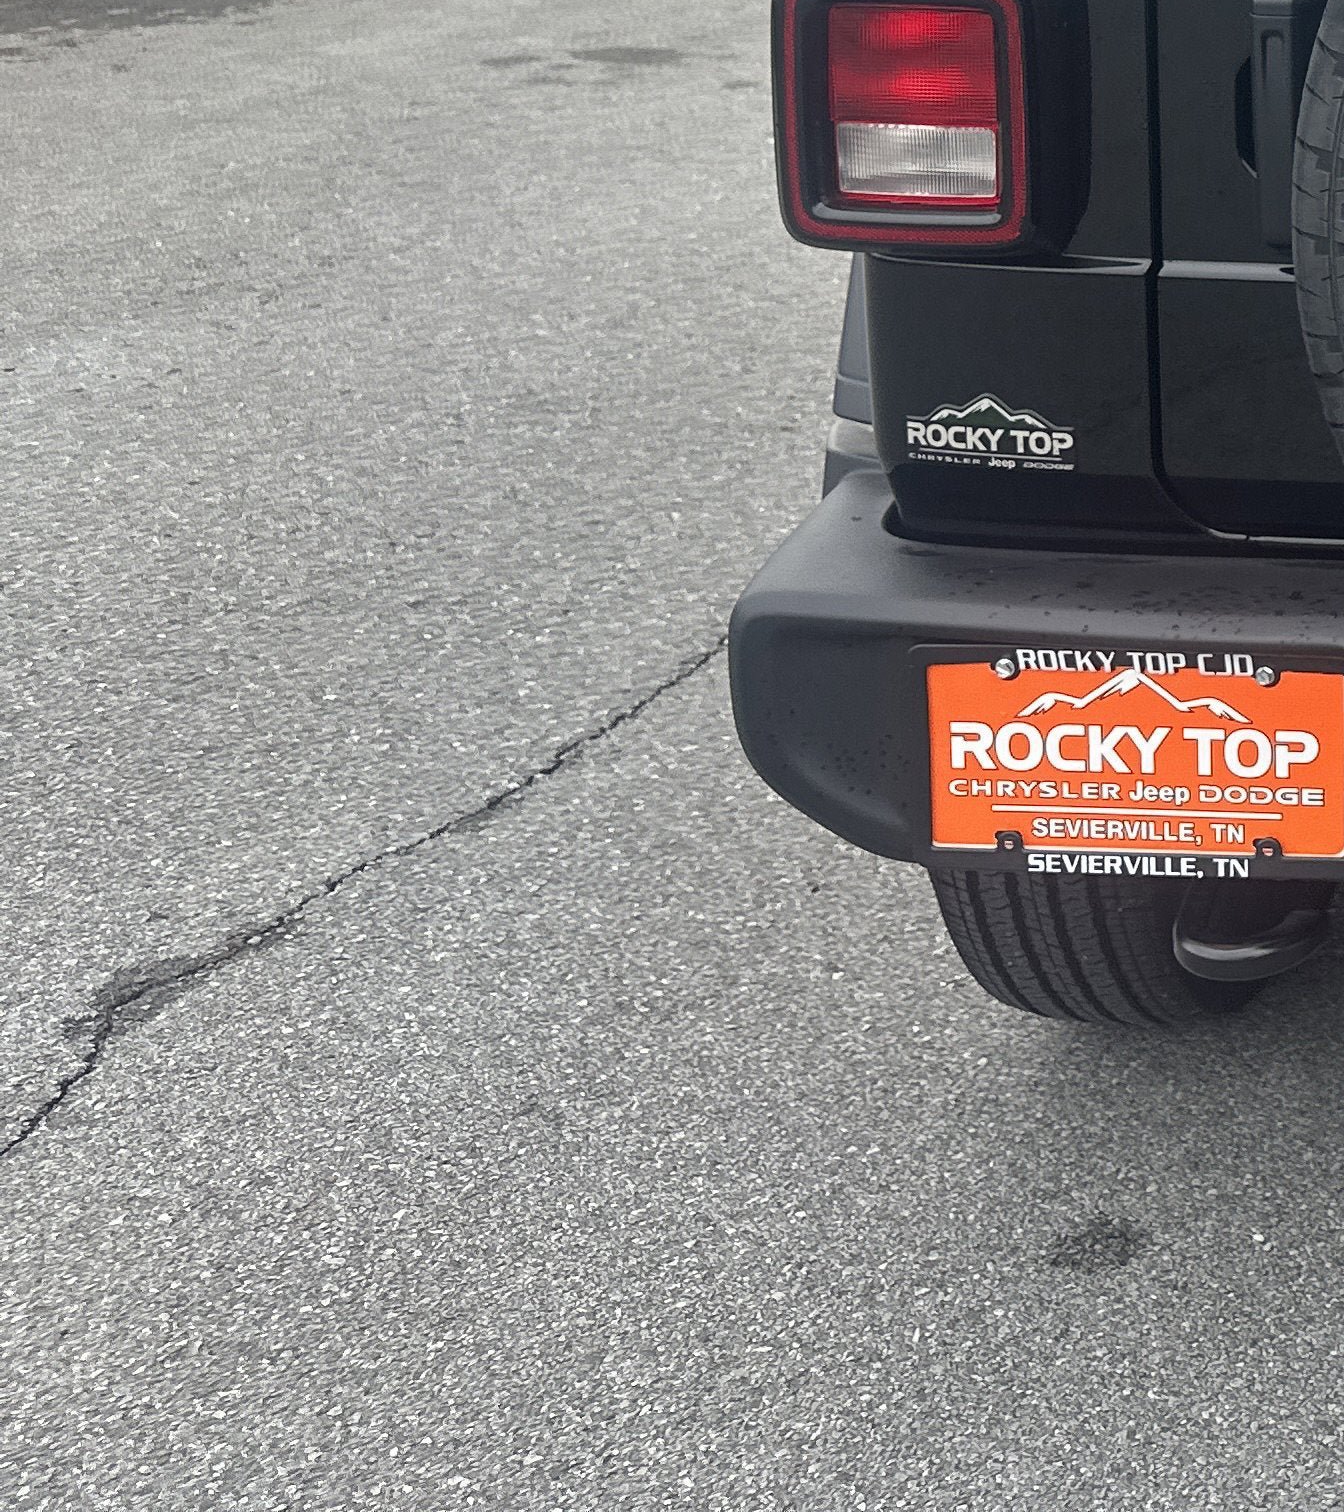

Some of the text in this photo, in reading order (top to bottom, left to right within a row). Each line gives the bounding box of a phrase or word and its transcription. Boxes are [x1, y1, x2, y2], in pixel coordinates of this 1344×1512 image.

[906, 420, 1075, 456] ROCKY TOP
[908, 452, 1075, 471] CHRYSLER Jeep DODGE
[1016, 648, 1255, 678] ROCKY TOP CJD
[949, 721, 1320, 779] ROCKY TOP
[948, 778, 1326, 807] CHRYSLER Jeep DODGE
[1031, 817, 1246, 847] SEVIERVILLE, TN
[1027, 853, 1250, 879] SEVIERVILLE, TN
